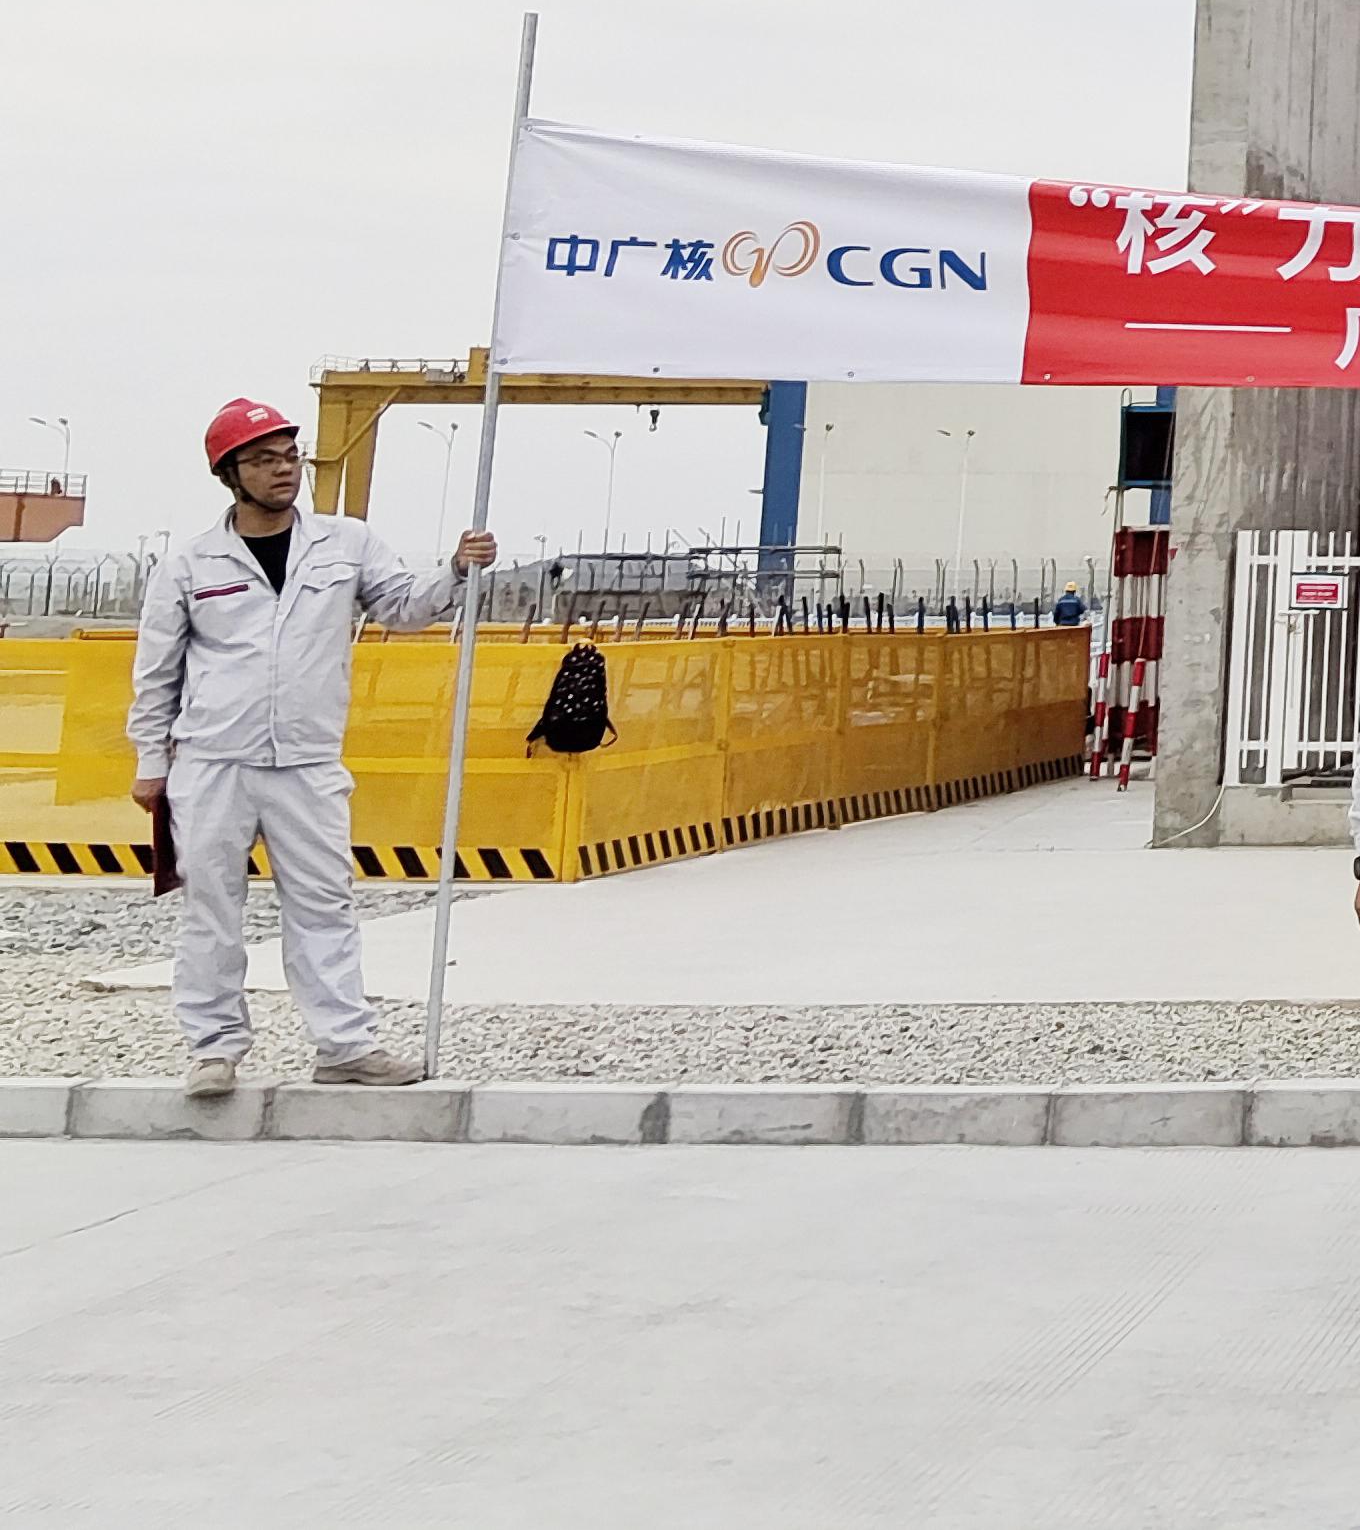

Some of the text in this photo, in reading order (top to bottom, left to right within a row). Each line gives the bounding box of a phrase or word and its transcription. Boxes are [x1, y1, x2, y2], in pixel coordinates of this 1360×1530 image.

[546, 234, 714, 281] 中广核
[826, 245, 988, 290] CGN
